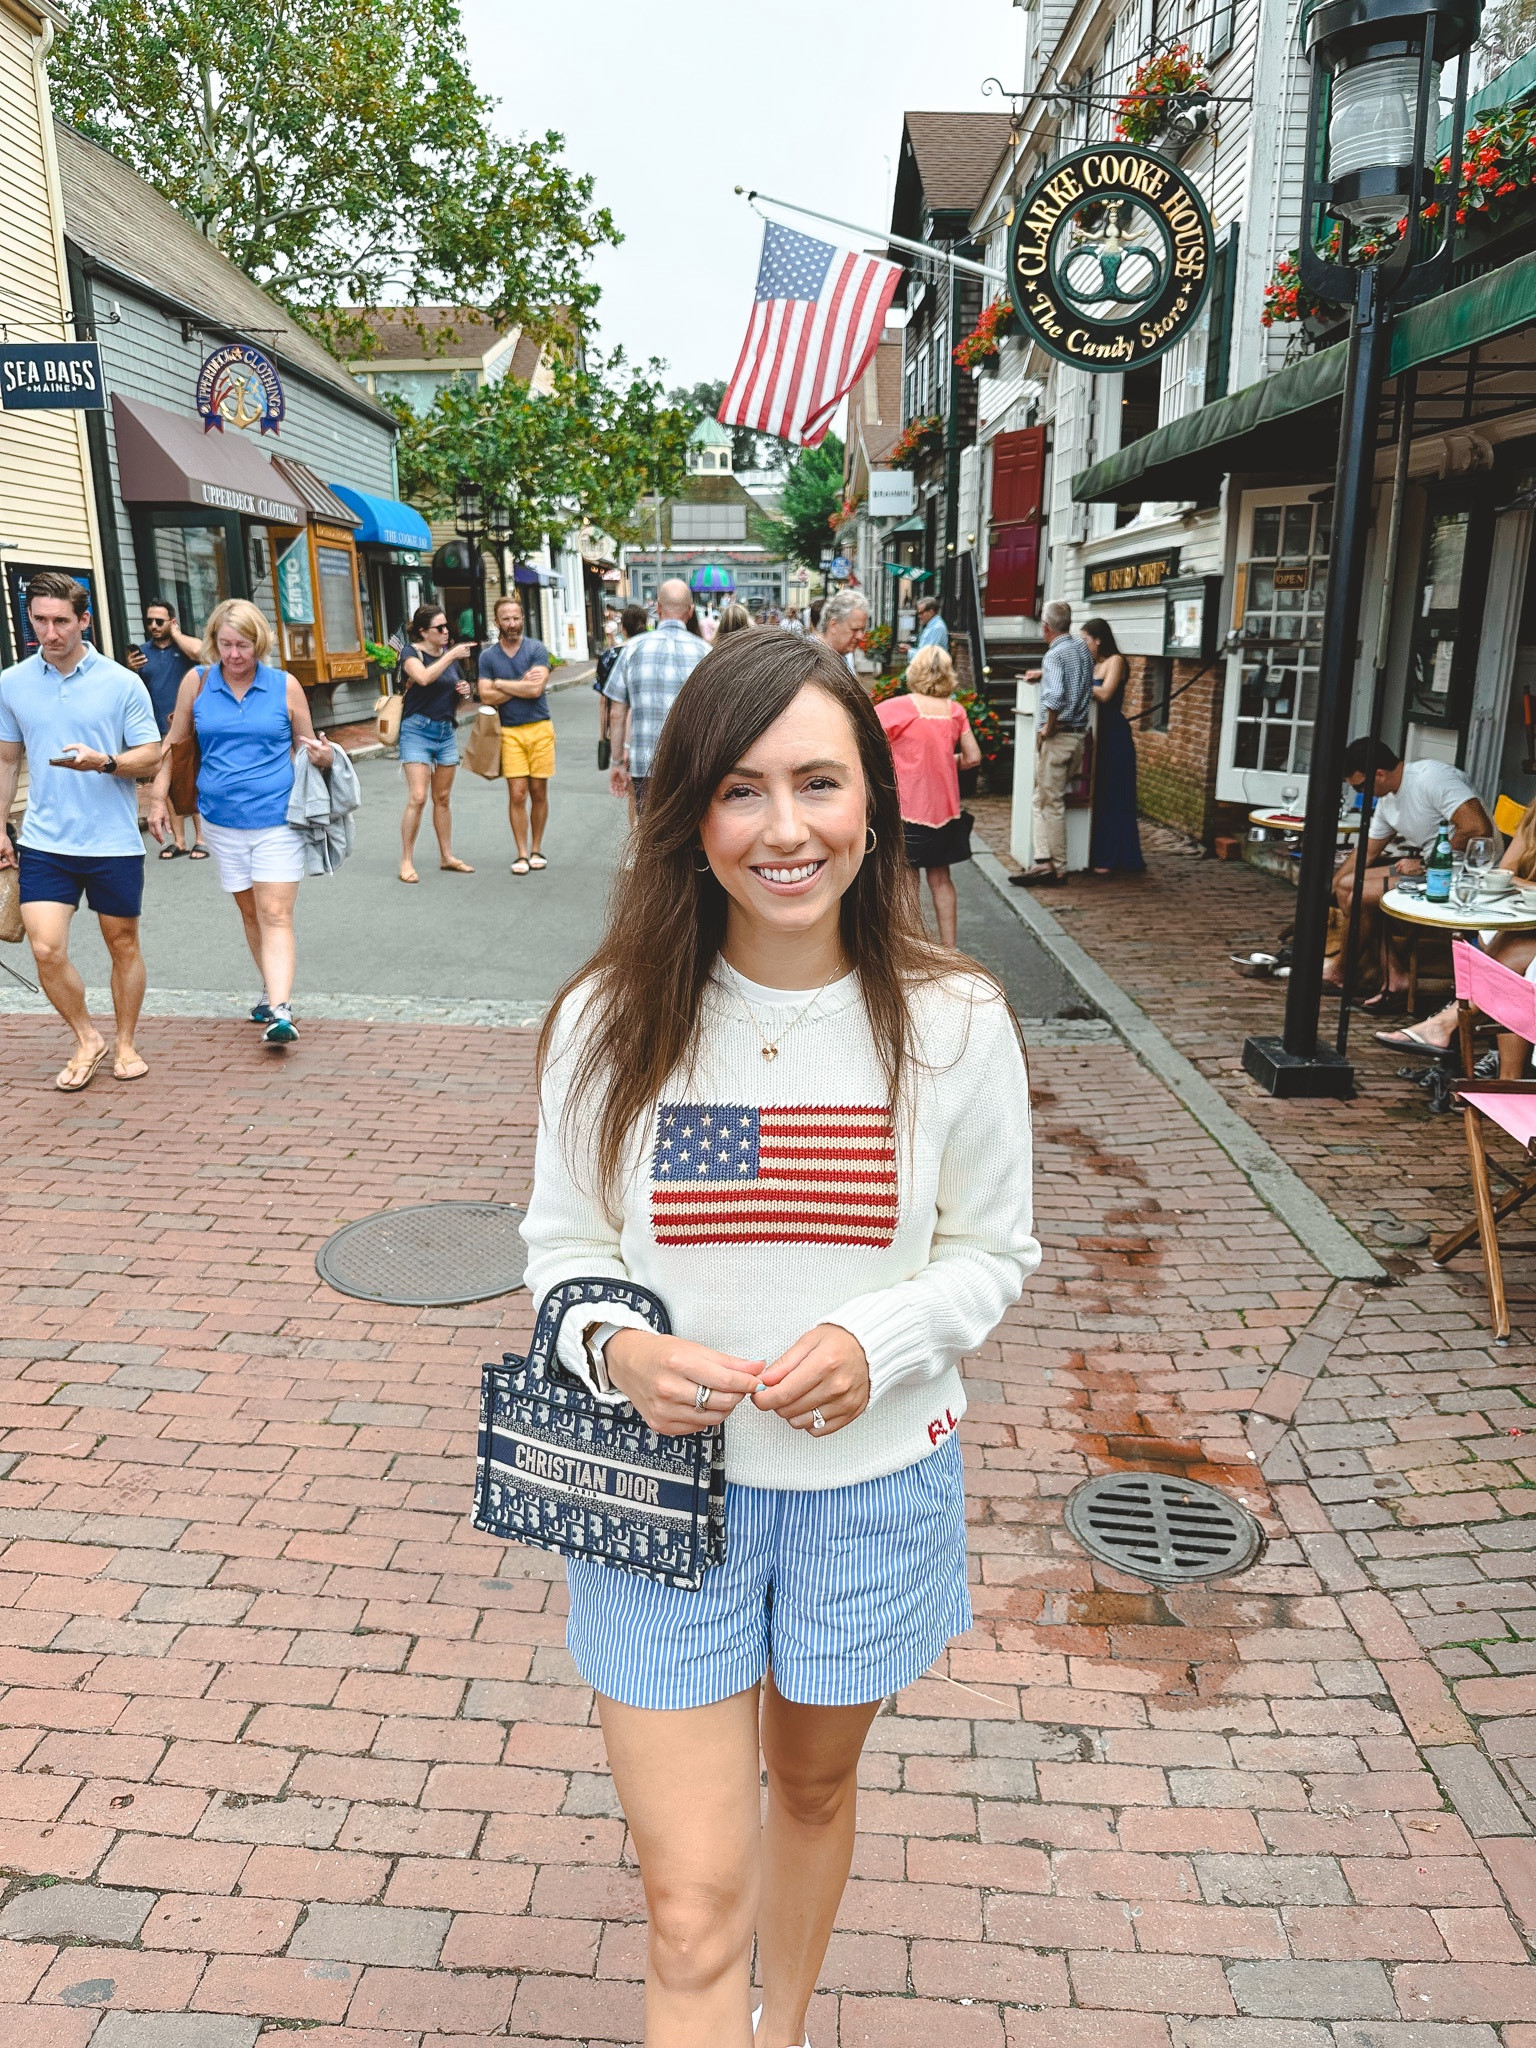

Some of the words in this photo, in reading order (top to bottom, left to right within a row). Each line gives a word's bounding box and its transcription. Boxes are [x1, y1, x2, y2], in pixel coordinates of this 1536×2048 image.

[1017, 167, 1084, 276] CLARKE
[1082, 155, 1171, 199] COOKE
[1160, 185, 1206, 280] HOUSE
[1029, 292, 1064, 338] The
[1066, 329, 1135, 362] Candy
[1139, 296, 1189, 348] Store
[3, 360, 40, 392] SEA
[44, 360, 96, 391] BAGS
[33, 384, 71, 392] MAINE
[244, 350, 281, 407] CLOTHING
[202, 483, 256, 513] UPPERDECK
[257, 497, 298, 524] CLOTHING
[285, 557, 304, 618] OPEN
[1275, 573, 1304, 584] OPEN
[514, 1444, 608, 1494] CHRISTIAN
[615, 1471, 660, 1505] DIOR
[567, 1485, 598, 1498] PARIS
